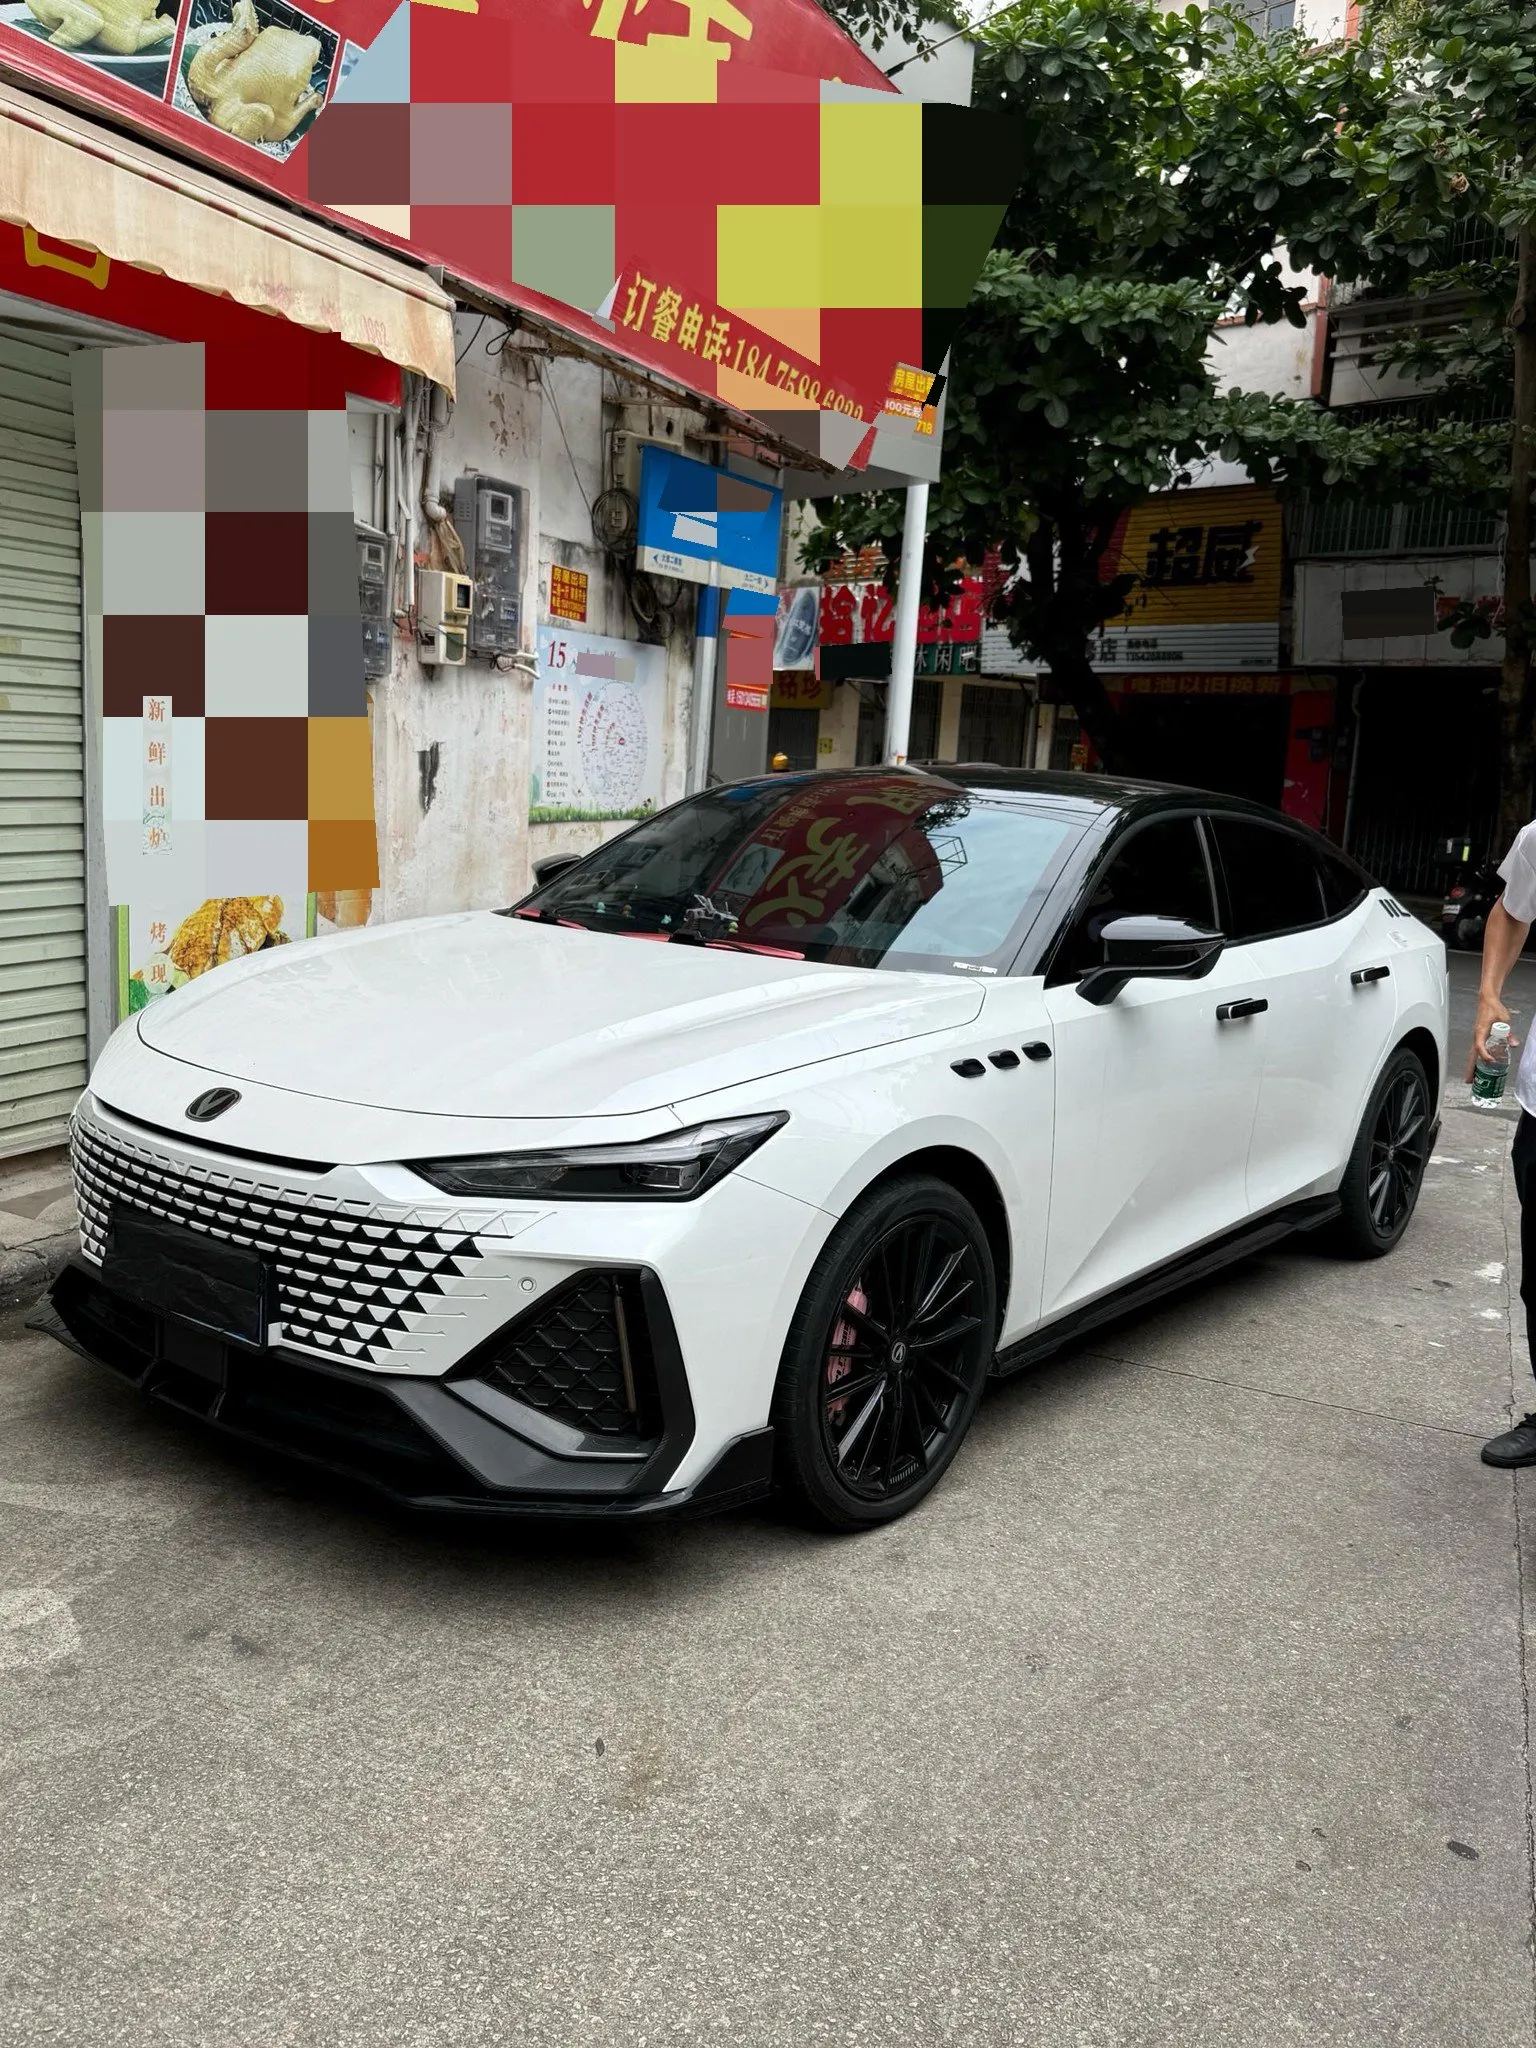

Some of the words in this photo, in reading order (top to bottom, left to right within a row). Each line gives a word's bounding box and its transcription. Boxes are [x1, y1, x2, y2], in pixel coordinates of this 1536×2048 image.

[548, 640, 567, 668] 15
[148, 698, 167, 849] 新鲜出炉
